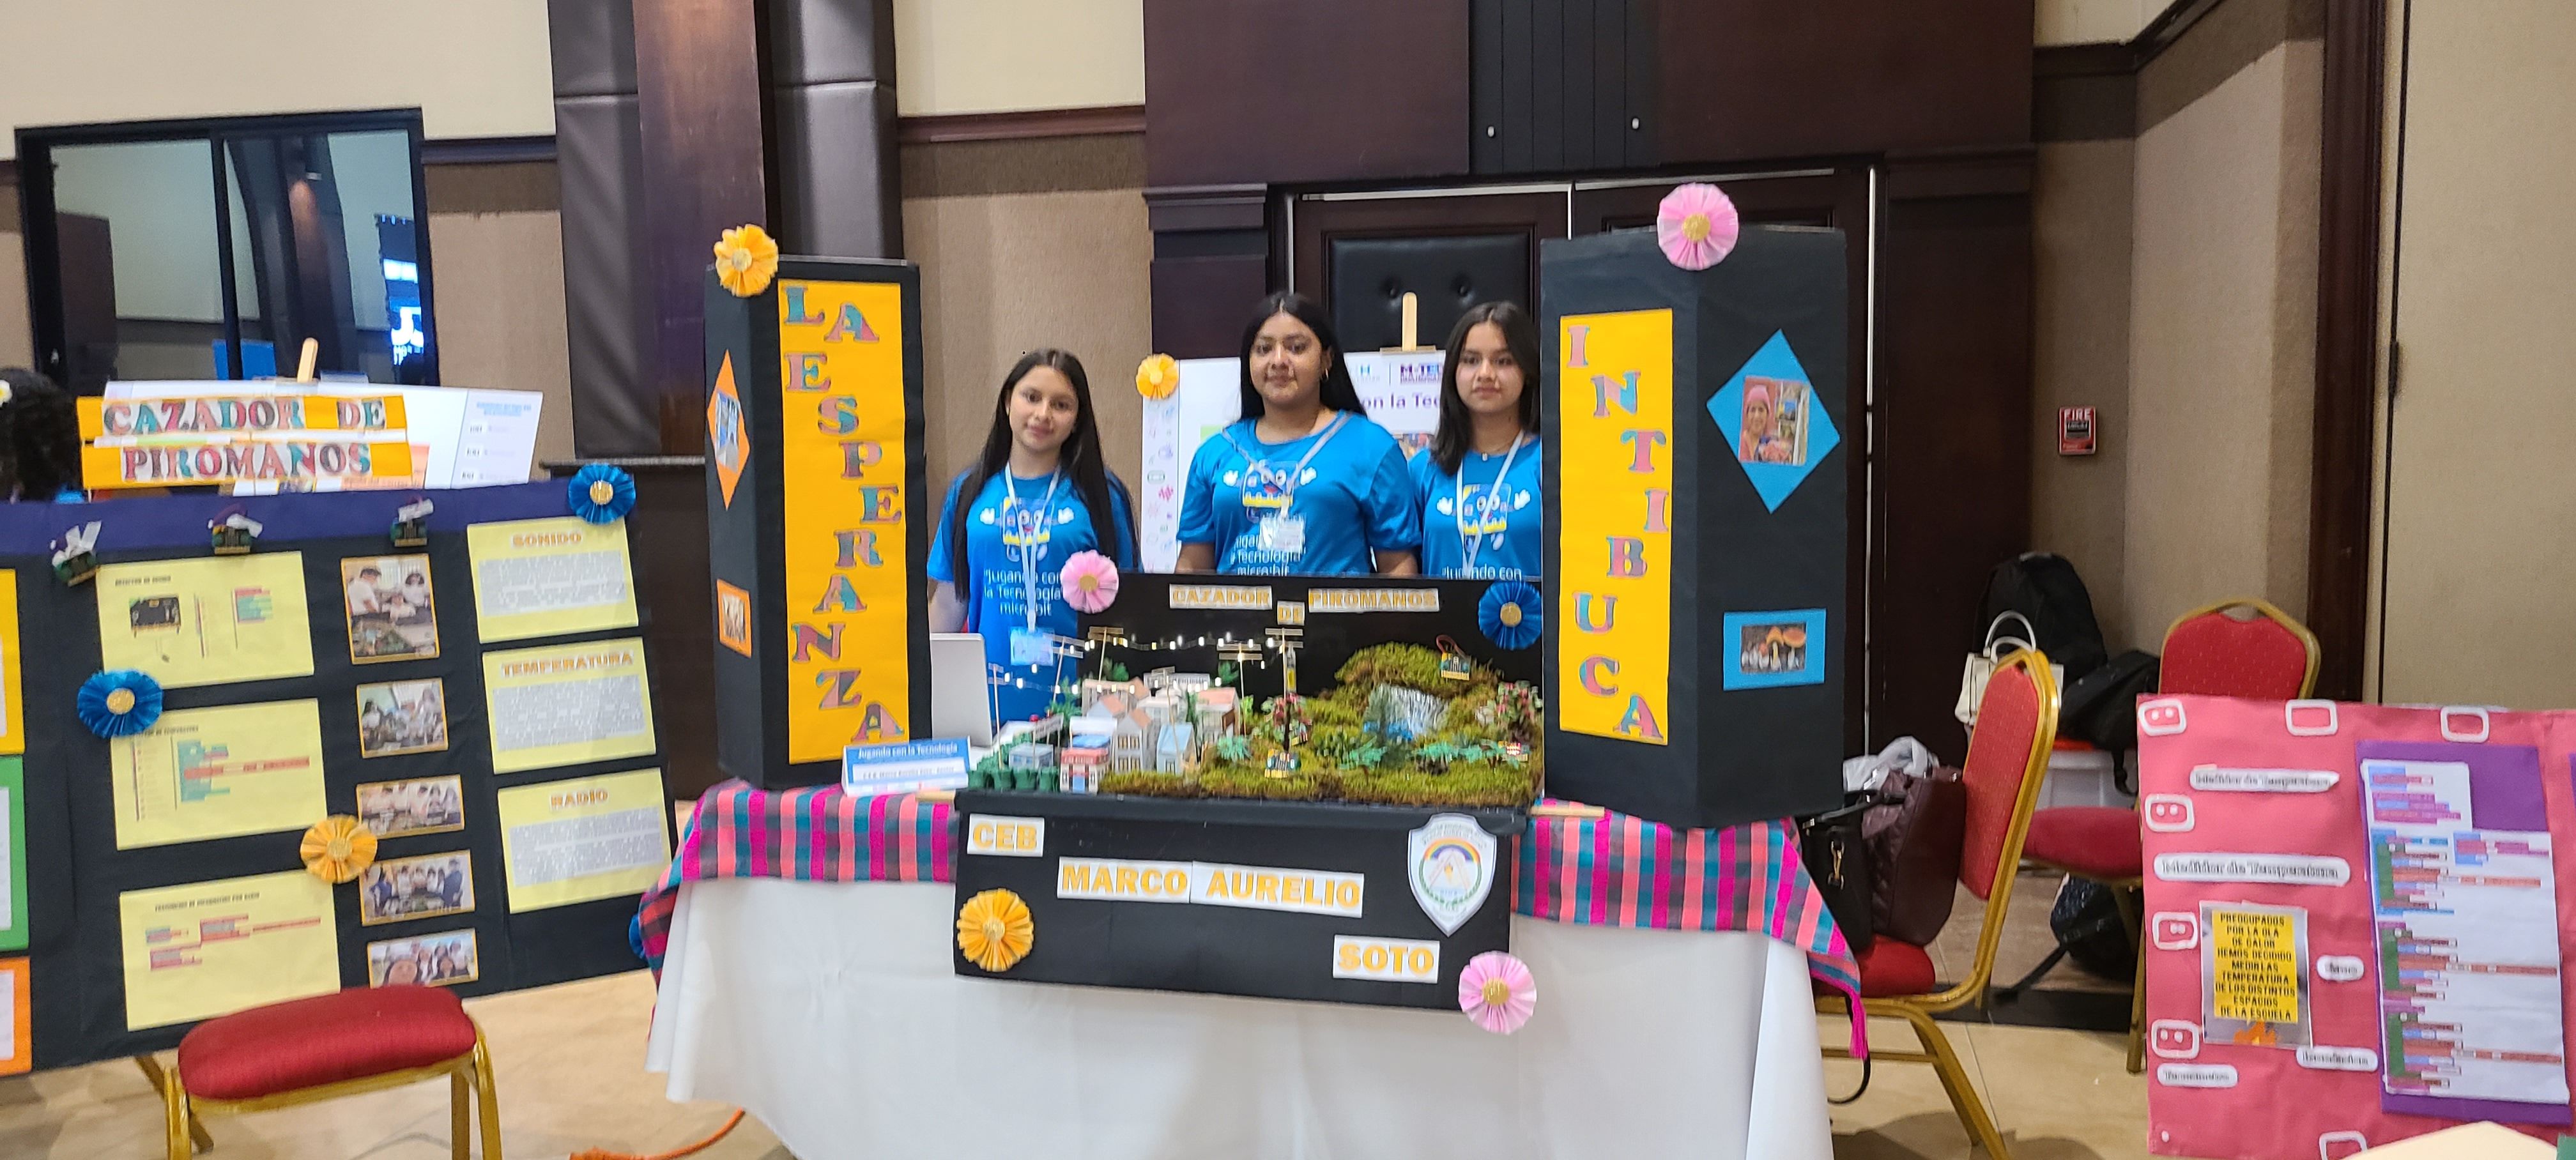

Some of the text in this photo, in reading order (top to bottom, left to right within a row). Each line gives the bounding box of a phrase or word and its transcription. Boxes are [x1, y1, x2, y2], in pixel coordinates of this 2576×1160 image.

[782, 286, 880, 342] LA
[1391, 392, 1406, 409] la
[2064, 408, 2090, 422] FIRE
[104, 396, 385, 435] CAZADOR DE
[123, 441, 371, 480] PIROMANOS
[513, 532, 582, 547] SONIDO
[1566, 324, 1669, 740] INTIBUCA
[785, 352, 905, 742] ESPERANZA
[1172, 587, 1436, 623] CAZADOR DE PIROMANOS
[502, 653, 632, 676] TEMPERATURA
[858, 746, 891, 759] Jugando
[893, 747, 907, 756] con
[908, 745, 915, 755] la
[551, 790, 608, 809] RADIO
[972, 822, 1038, 851] CEB
[1061, 866, 1361, 910] MARCO AURELIO
[1337, 944, 1436, 976] SOTO
[2218, 947, 2249, 958] HEMOS
[2223, 971, 2289, 985] TEMPERATURA
